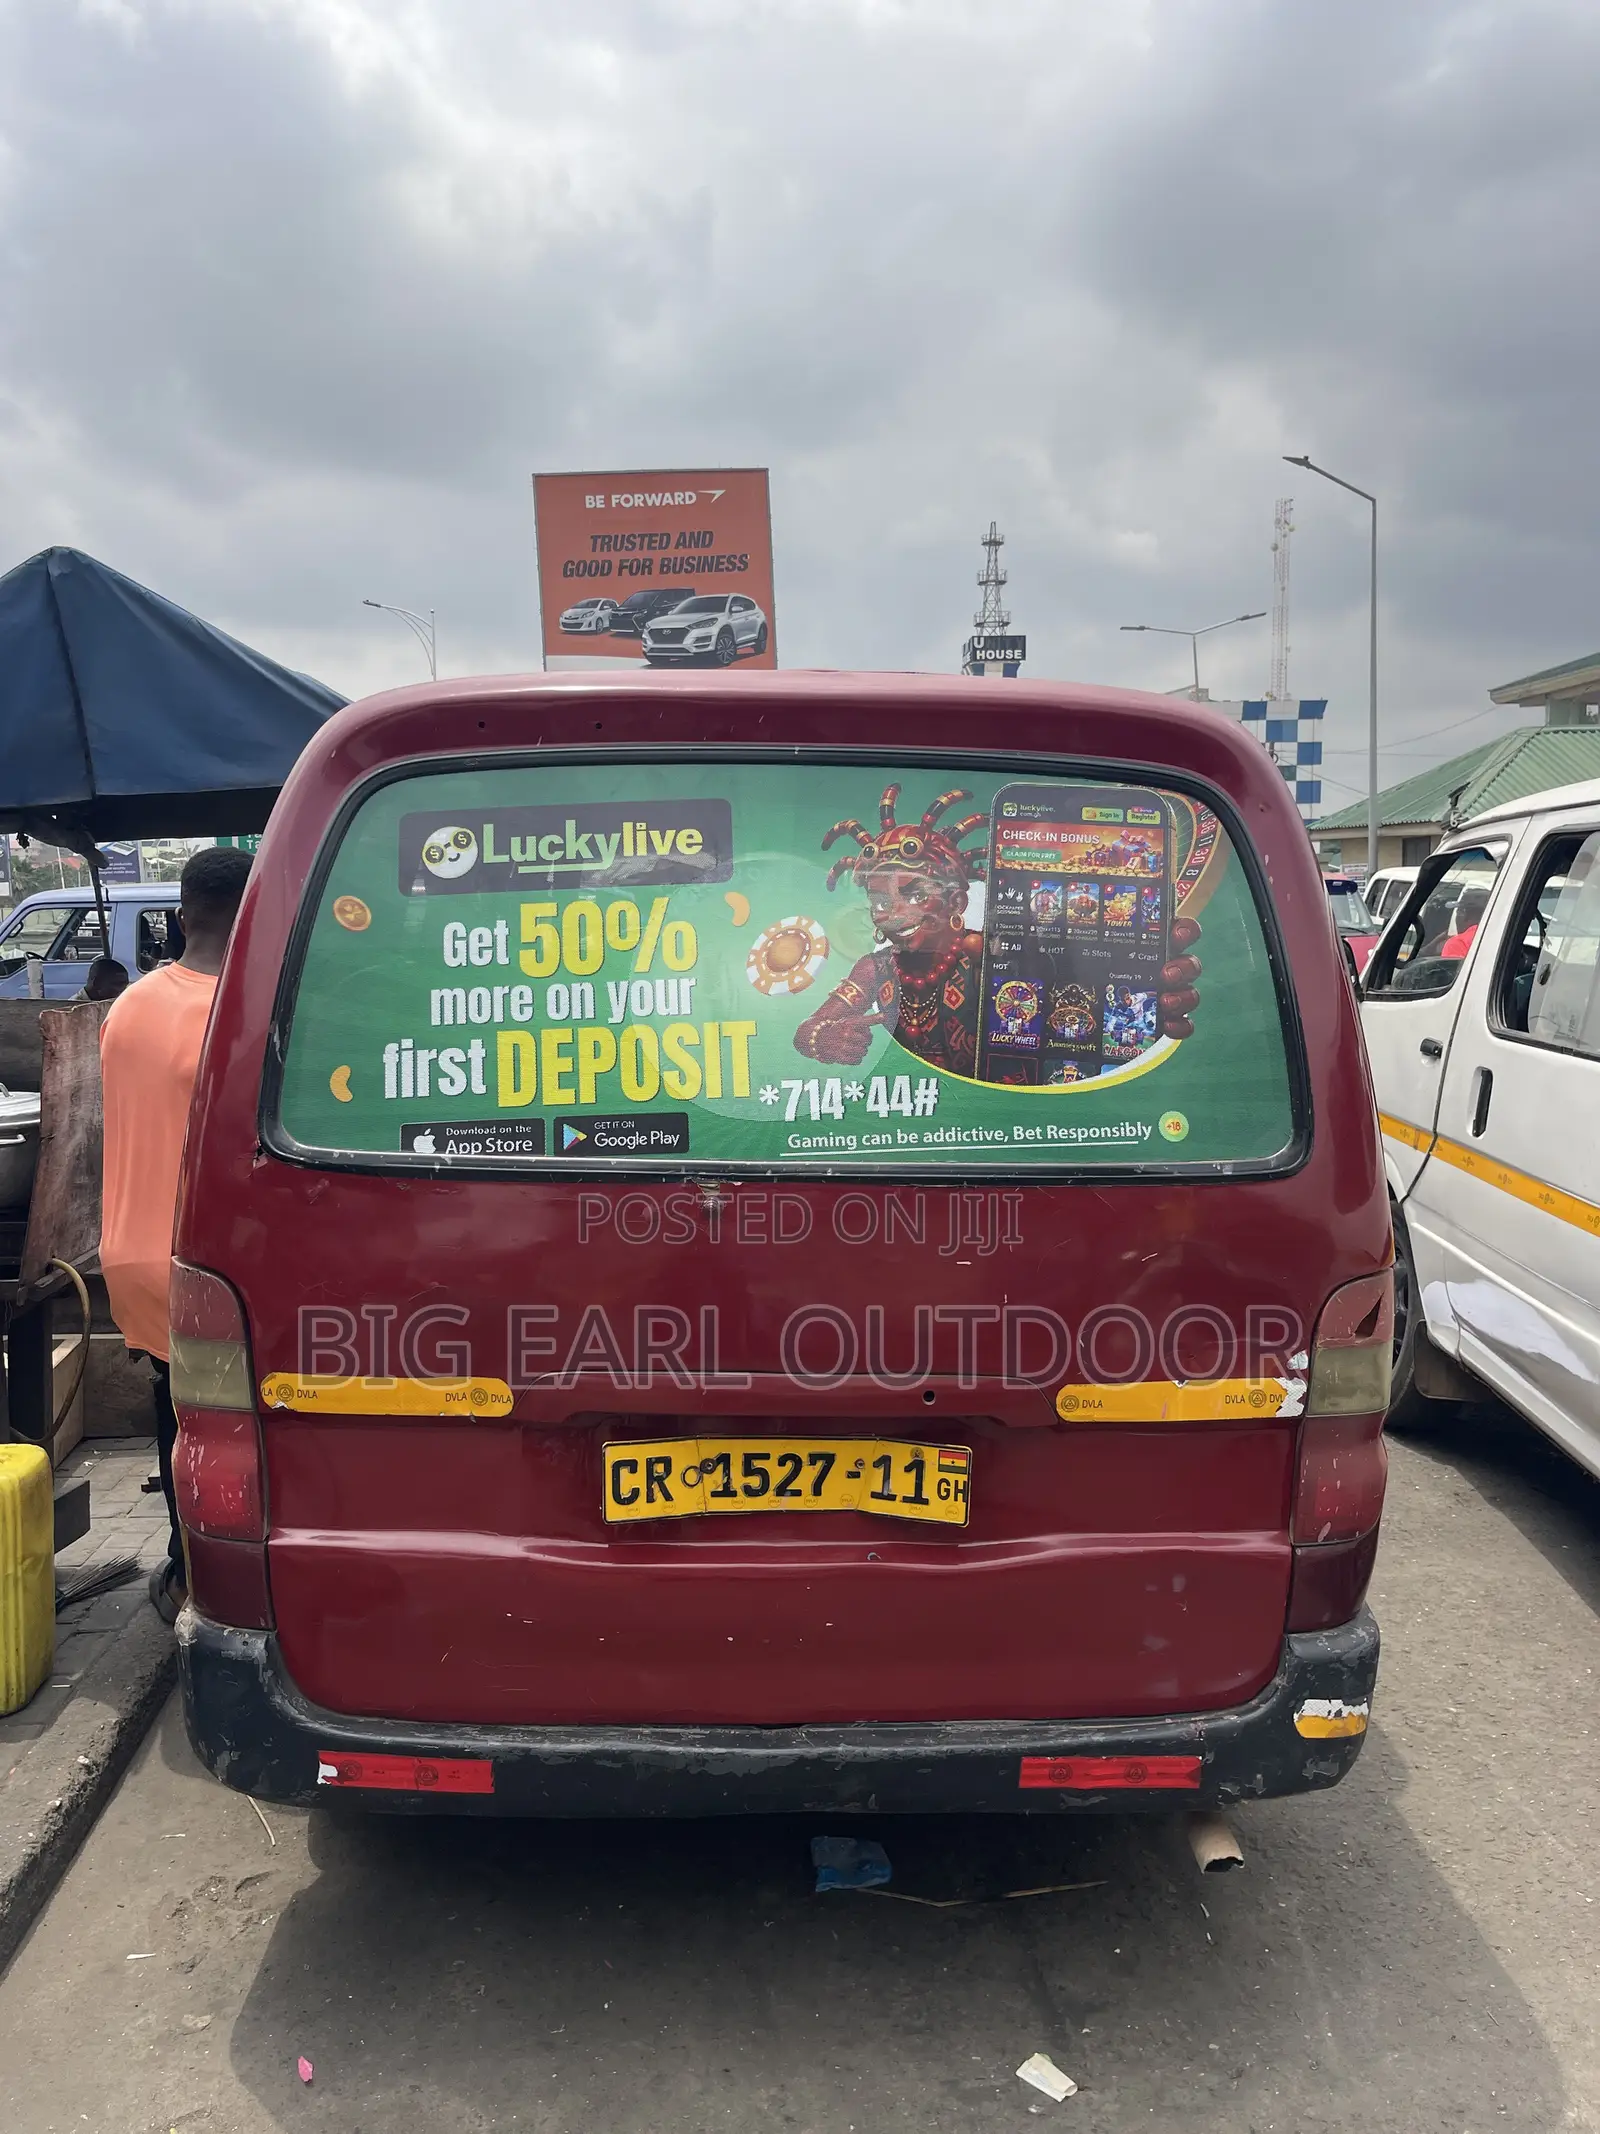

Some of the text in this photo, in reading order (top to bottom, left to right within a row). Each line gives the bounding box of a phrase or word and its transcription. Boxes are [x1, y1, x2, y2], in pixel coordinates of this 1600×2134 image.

[585, 491, 697, 508] BE FORWARD
[590, 530, 714, 552] TRUSTED AND
[562, 554, 749, 578] GOOD FOR BUSINESS
[976, 649, 1022, 660] HOUSE
[1098, 811, 1112, 819] Sign
[1131, 813, 1157, 822] Register
[1002, 829, 1100, 845] CHECK-IN BONUS
[483, 819, 704, 872] Luckylive
[1106, 920, 1133, 928] TOWER
[443, 896, 699, 978] Get 50%
[1091, 949, 1112, 958] Slots
[993, 962, 1008, 970] HOT
[430, 976, 698, 1026] more on your
[991, 1031, 1015, 1043] LUCKY
[1014, 1035, 1037, 1046] WHEEL
[382, 1019, 758, 1108] first DEPOSIT
[445, 1123, 532, 1137] Download on the
[594, 1119, 635, 1130] GET IT ON
[594, 1130, 680, 1150] Google Play
[787, 1121, 1152, 1150] Gaming can be addictive, Bet Responsibly
[445, 1136, 533, 1156] App Store
[297, 1389, 318, 1399] DVLA
[445, 1392, 512, 1403] DVLA DVLA
[1225, 1395, 1246, 1404] DVLA
[1082, 1399, 1103, 1408] DVLA
[611, 1456, 675, 1506] CR
[936, 1477, 968, 1503] GH
